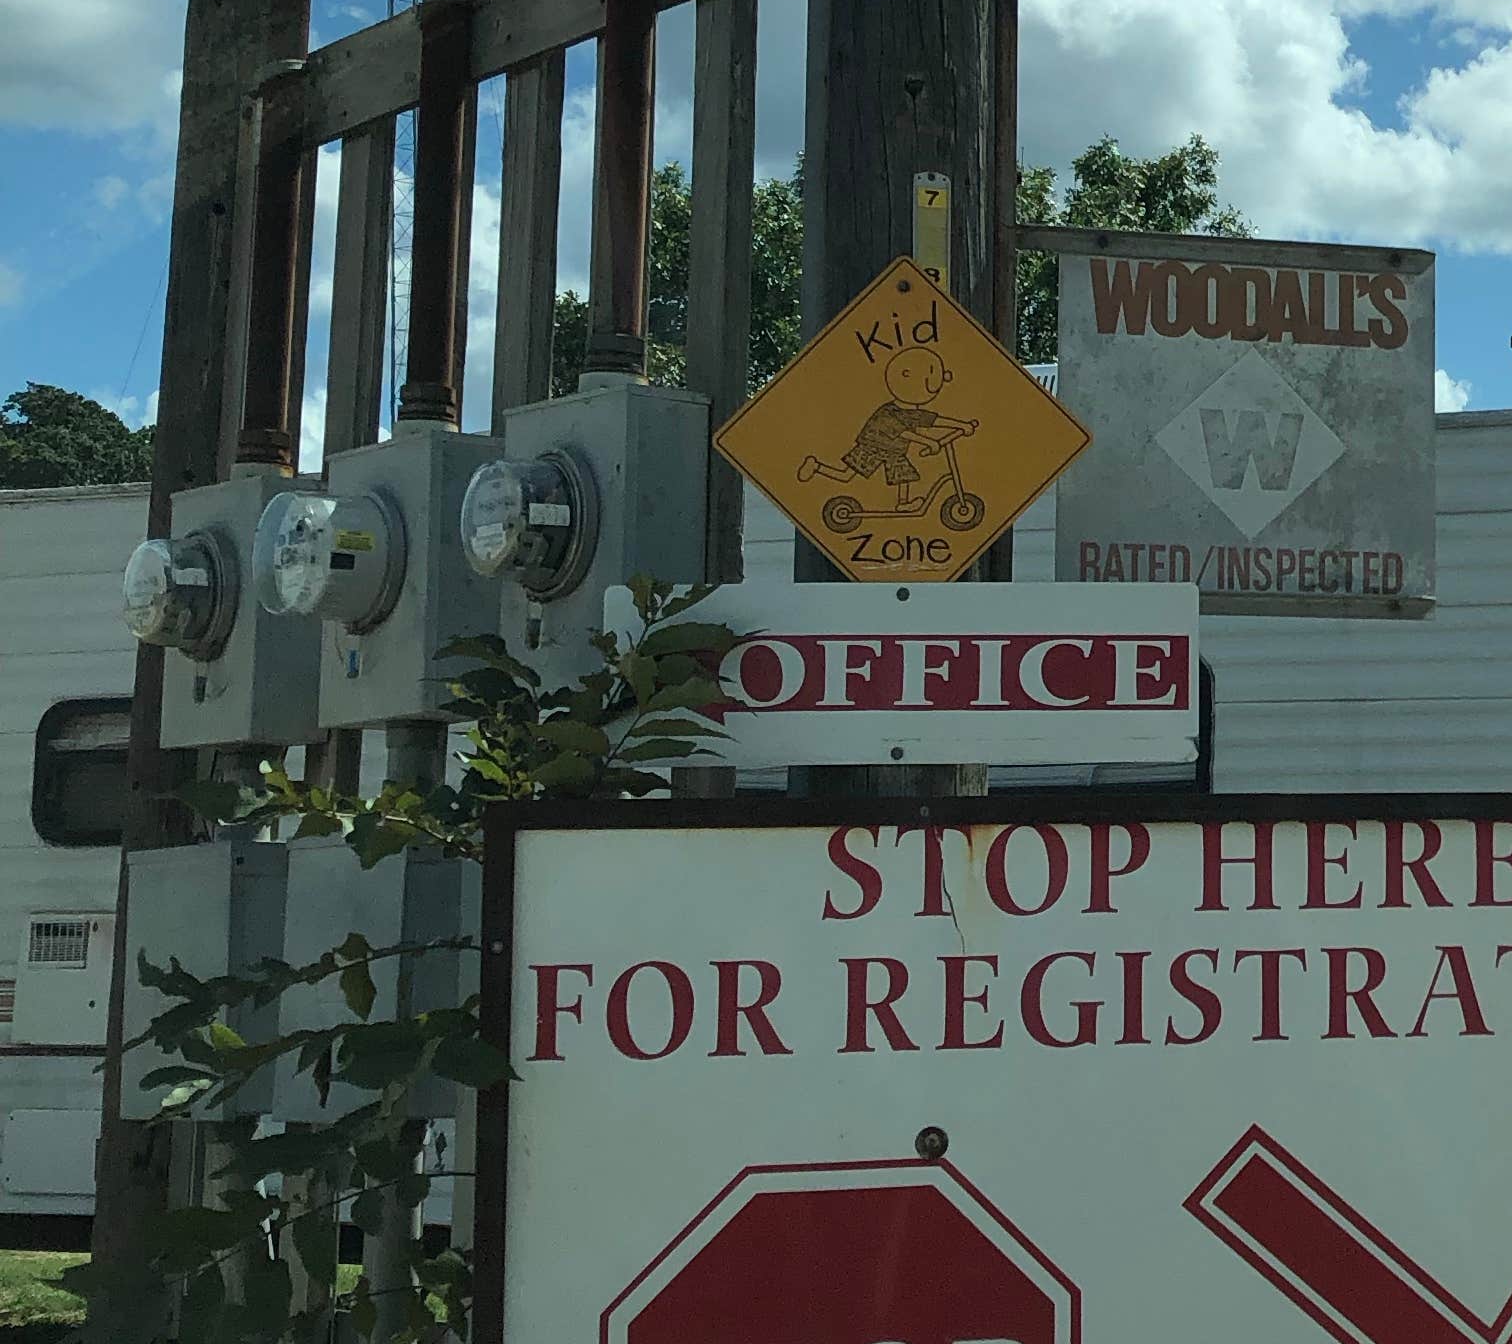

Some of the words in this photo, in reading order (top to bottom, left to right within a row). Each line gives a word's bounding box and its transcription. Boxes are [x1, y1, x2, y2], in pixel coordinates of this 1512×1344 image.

[924, 189, 940, 206] 7
[855, 301, 939, 364] Kid
[1090, 258, 1409, 350] WOODALL'S
[850, 533, 953, 566] Zone
[719, 637, 1180, 708] OFFICE
[822, 822, 1151, 921] STOP
[525, 960, 794, 1062] FOR
